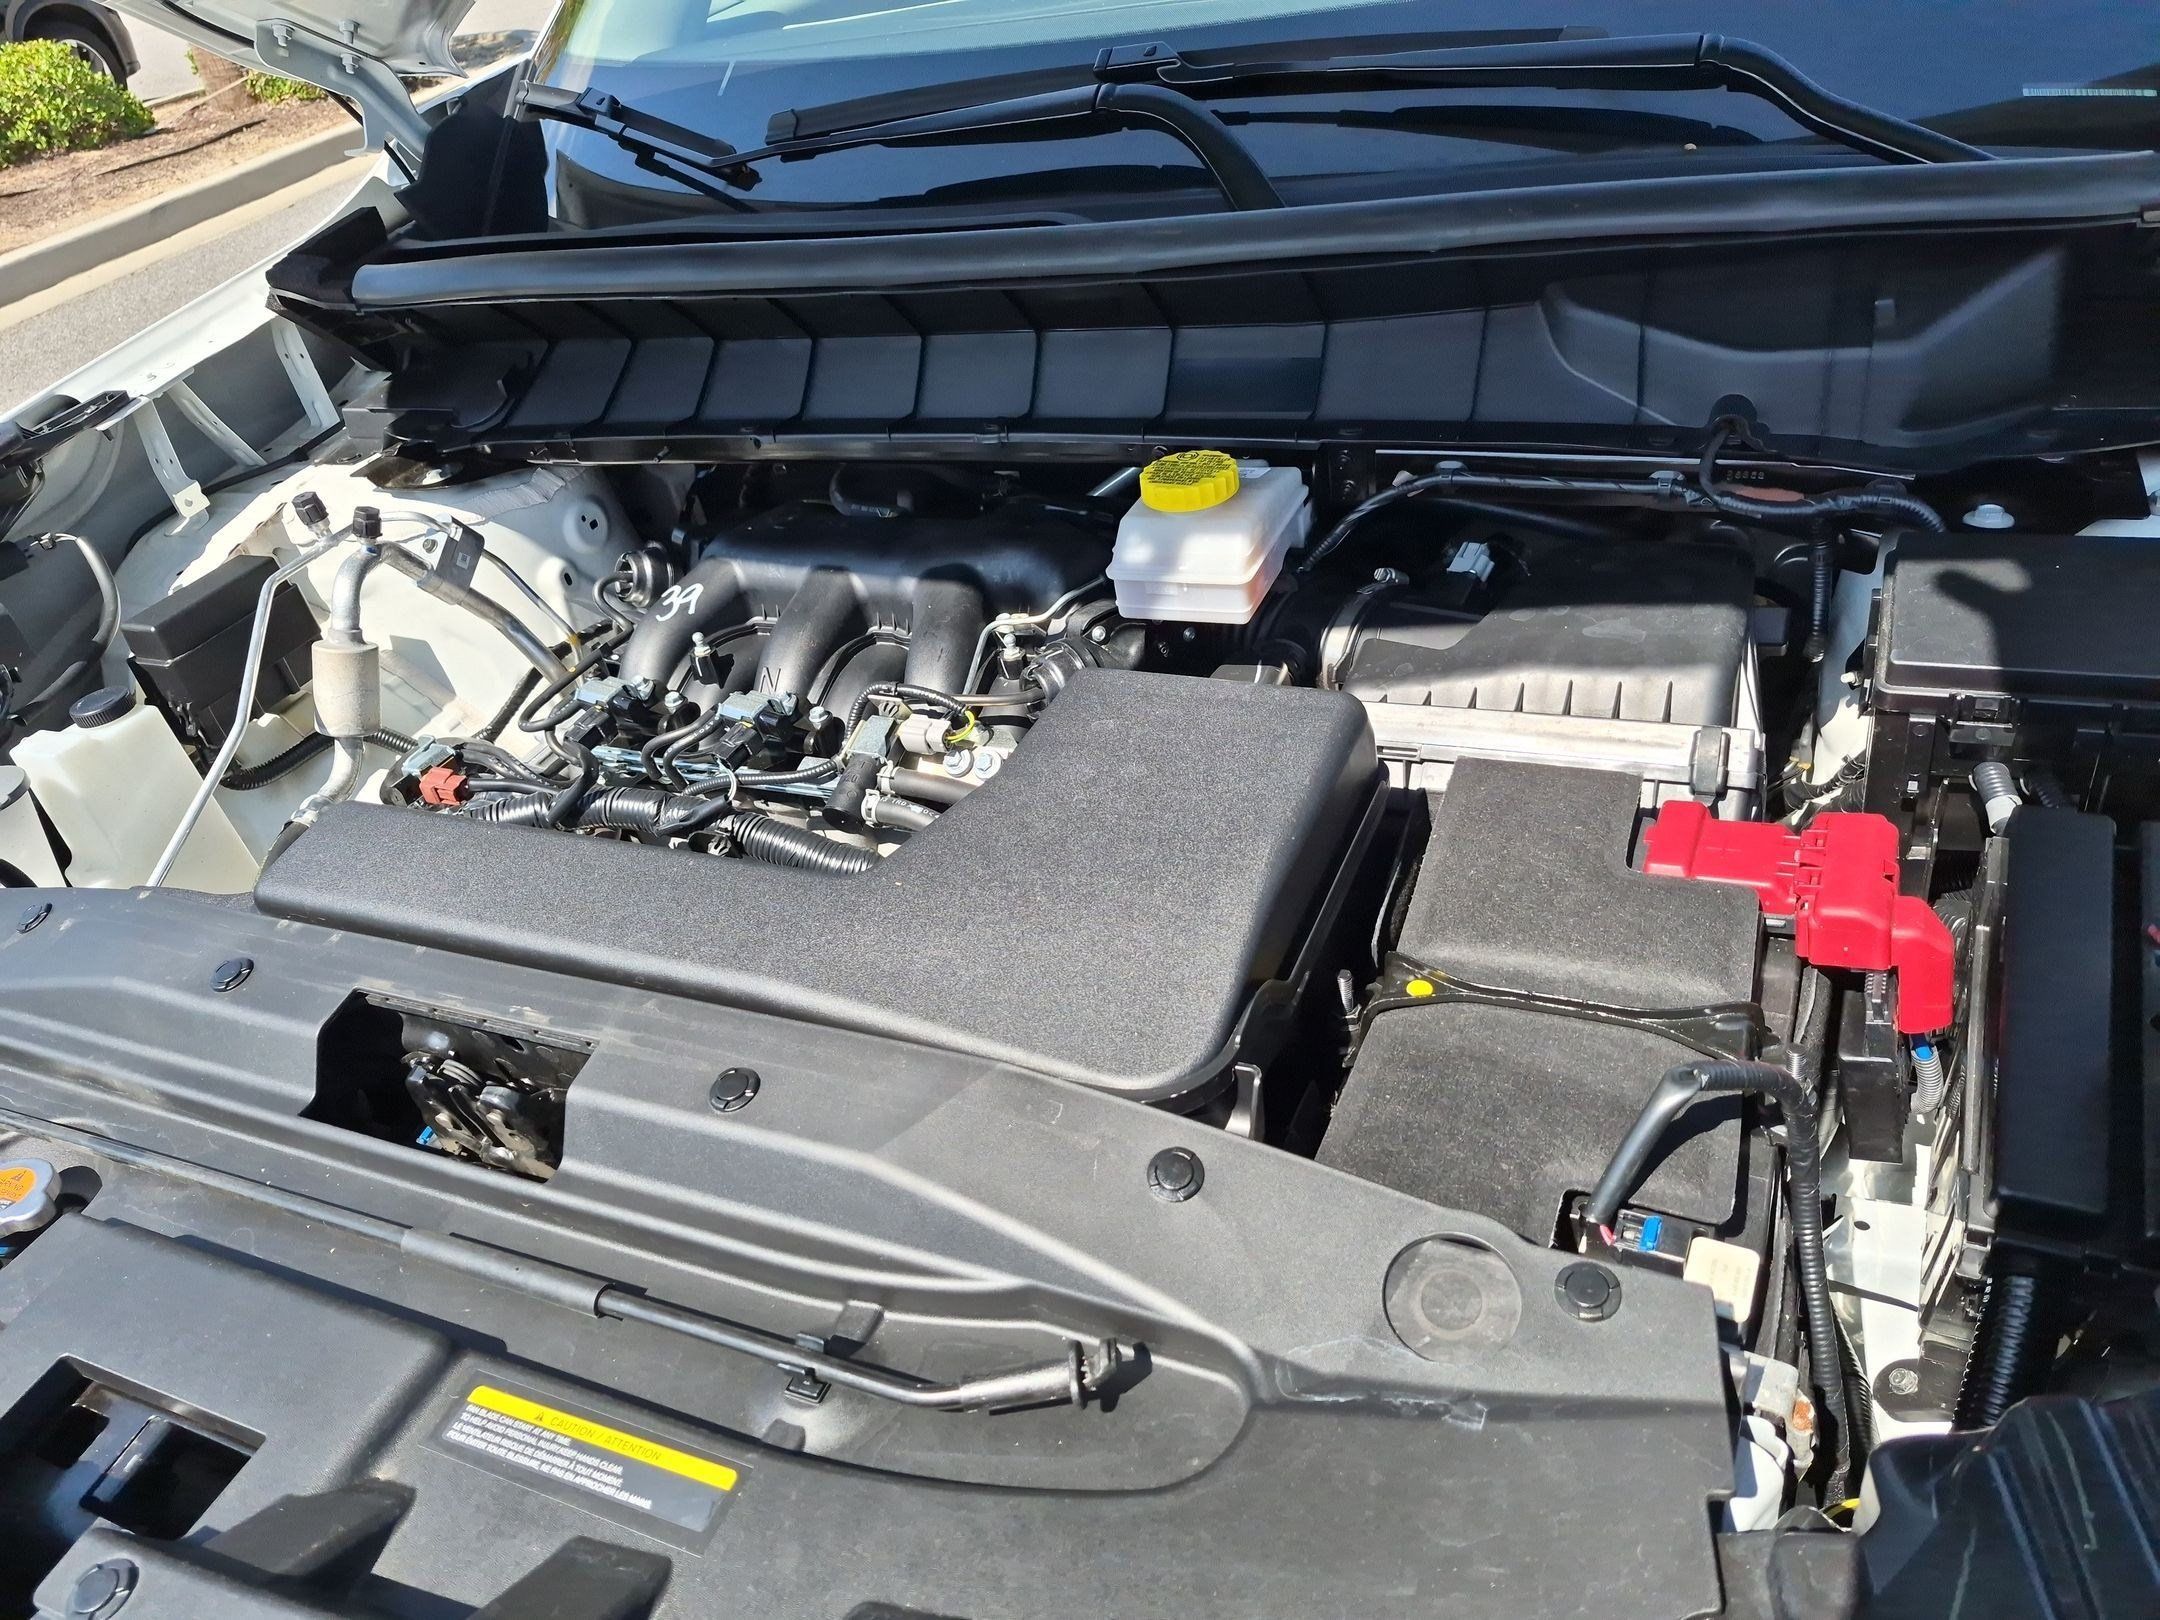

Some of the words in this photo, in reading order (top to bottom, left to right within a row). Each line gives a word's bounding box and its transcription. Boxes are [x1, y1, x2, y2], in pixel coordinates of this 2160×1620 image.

[655, 583, 704, 621] 39
[550, 1416, 595, 1438] CAUTION
[605, 1435, 662, 1461] ATTENTION
